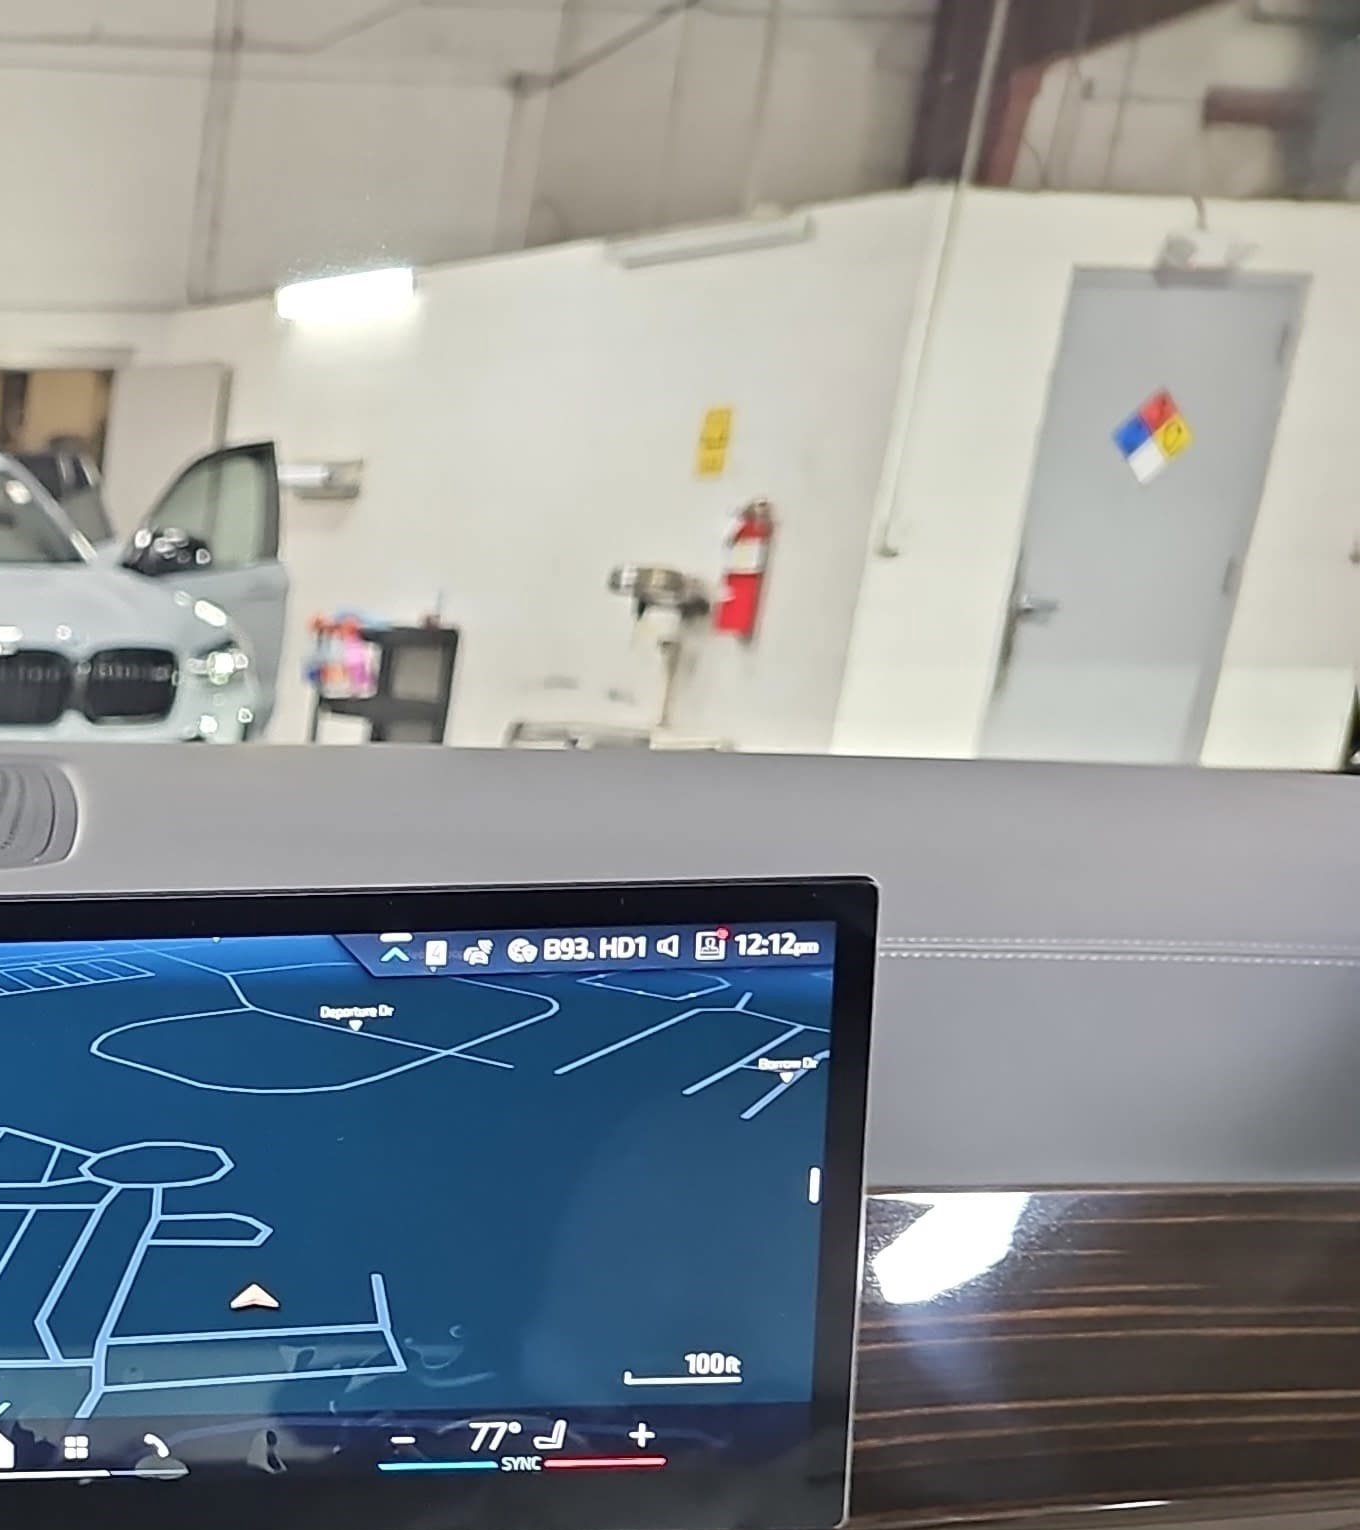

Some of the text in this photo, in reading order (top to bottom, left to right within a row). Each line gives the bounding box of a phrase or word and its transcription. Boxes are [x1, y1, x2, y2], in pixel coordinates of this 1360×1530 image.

[544, 936, 647, 960] B93. HD1
[378, 1004, 394, 1017] Dr
[501, 1456, 542, 1471] SYNC
